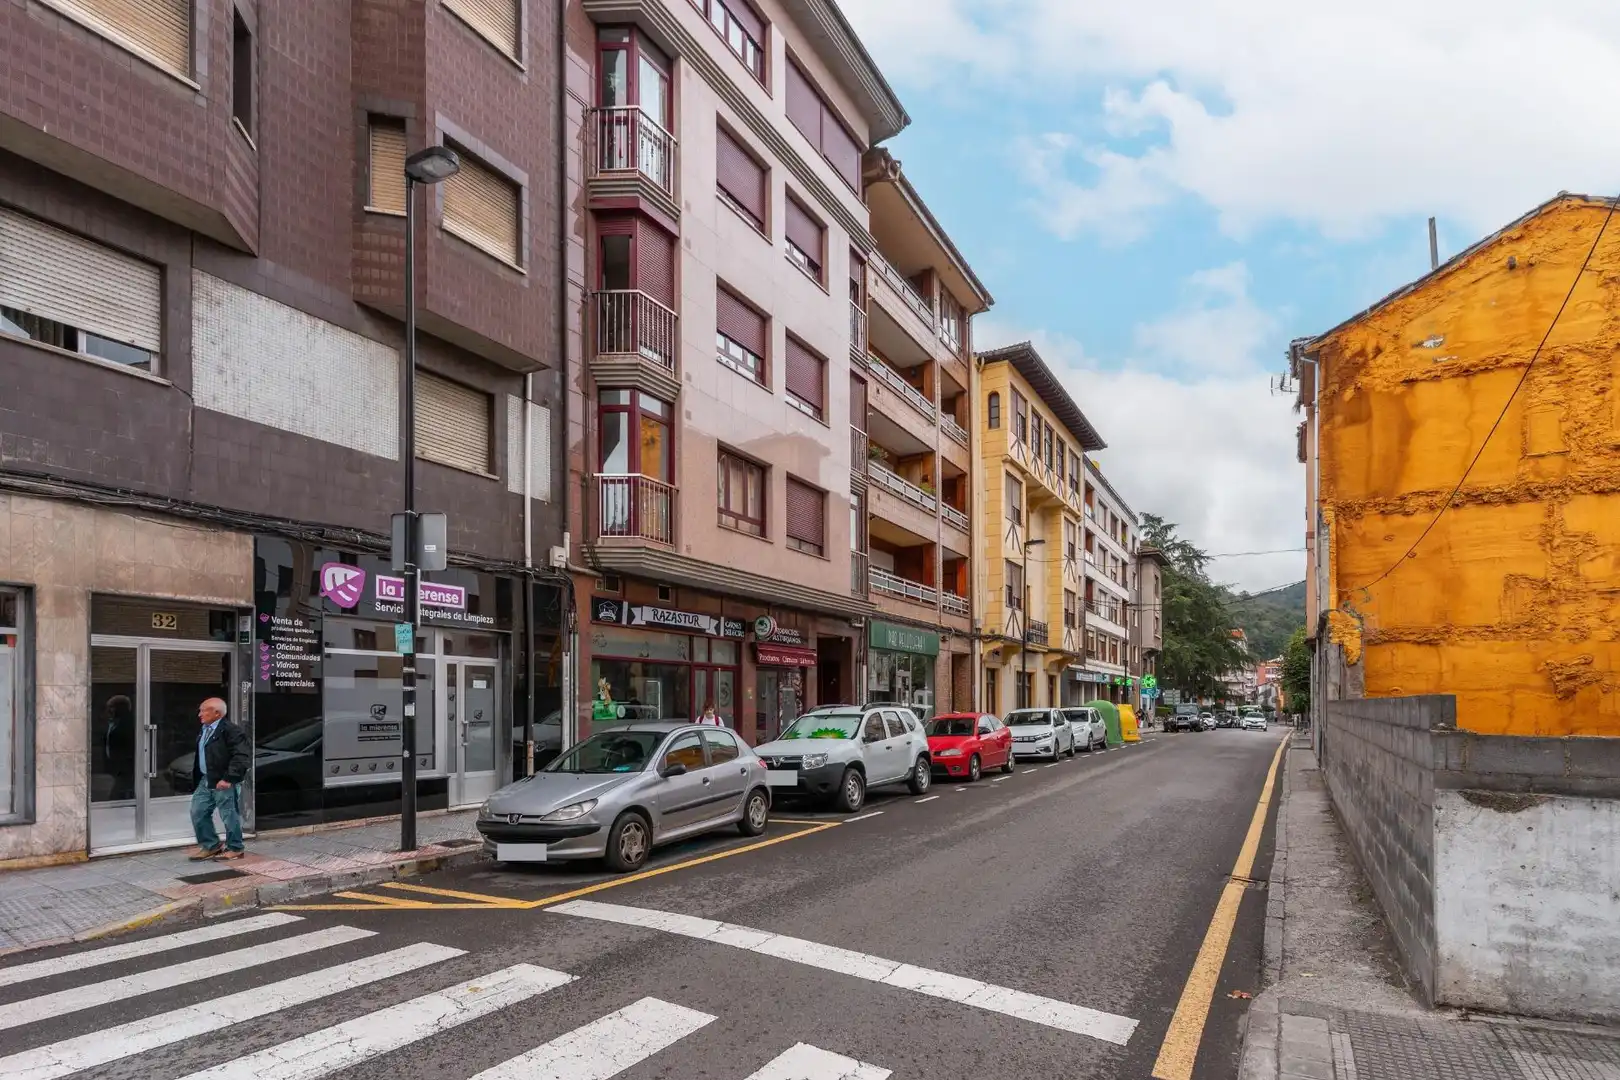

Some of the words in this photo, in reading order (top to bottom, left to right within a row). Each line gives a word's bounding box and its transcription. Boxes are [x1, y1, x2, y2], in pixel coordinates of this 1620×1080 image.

[382, 581, 395, 596] la
[401, 584, 459, 604] erense
[375, 602, 404, 614] Servici
[453, 611, 462, 621] de
[464, 613, 494, 625] Limpieza
[651, 608, 700, 627] RAZASTUR
[153, 613, 176, 628] 32
[271, 616, 292, 625] Venta
[294, 618, 303, 626] de
[276, 643, 304, 652] Oficinas
[276, 652, 321, 661] Comunidades
[276, 661, 300, 669] Vidrios
[275, 670, 302, 678] Locales
